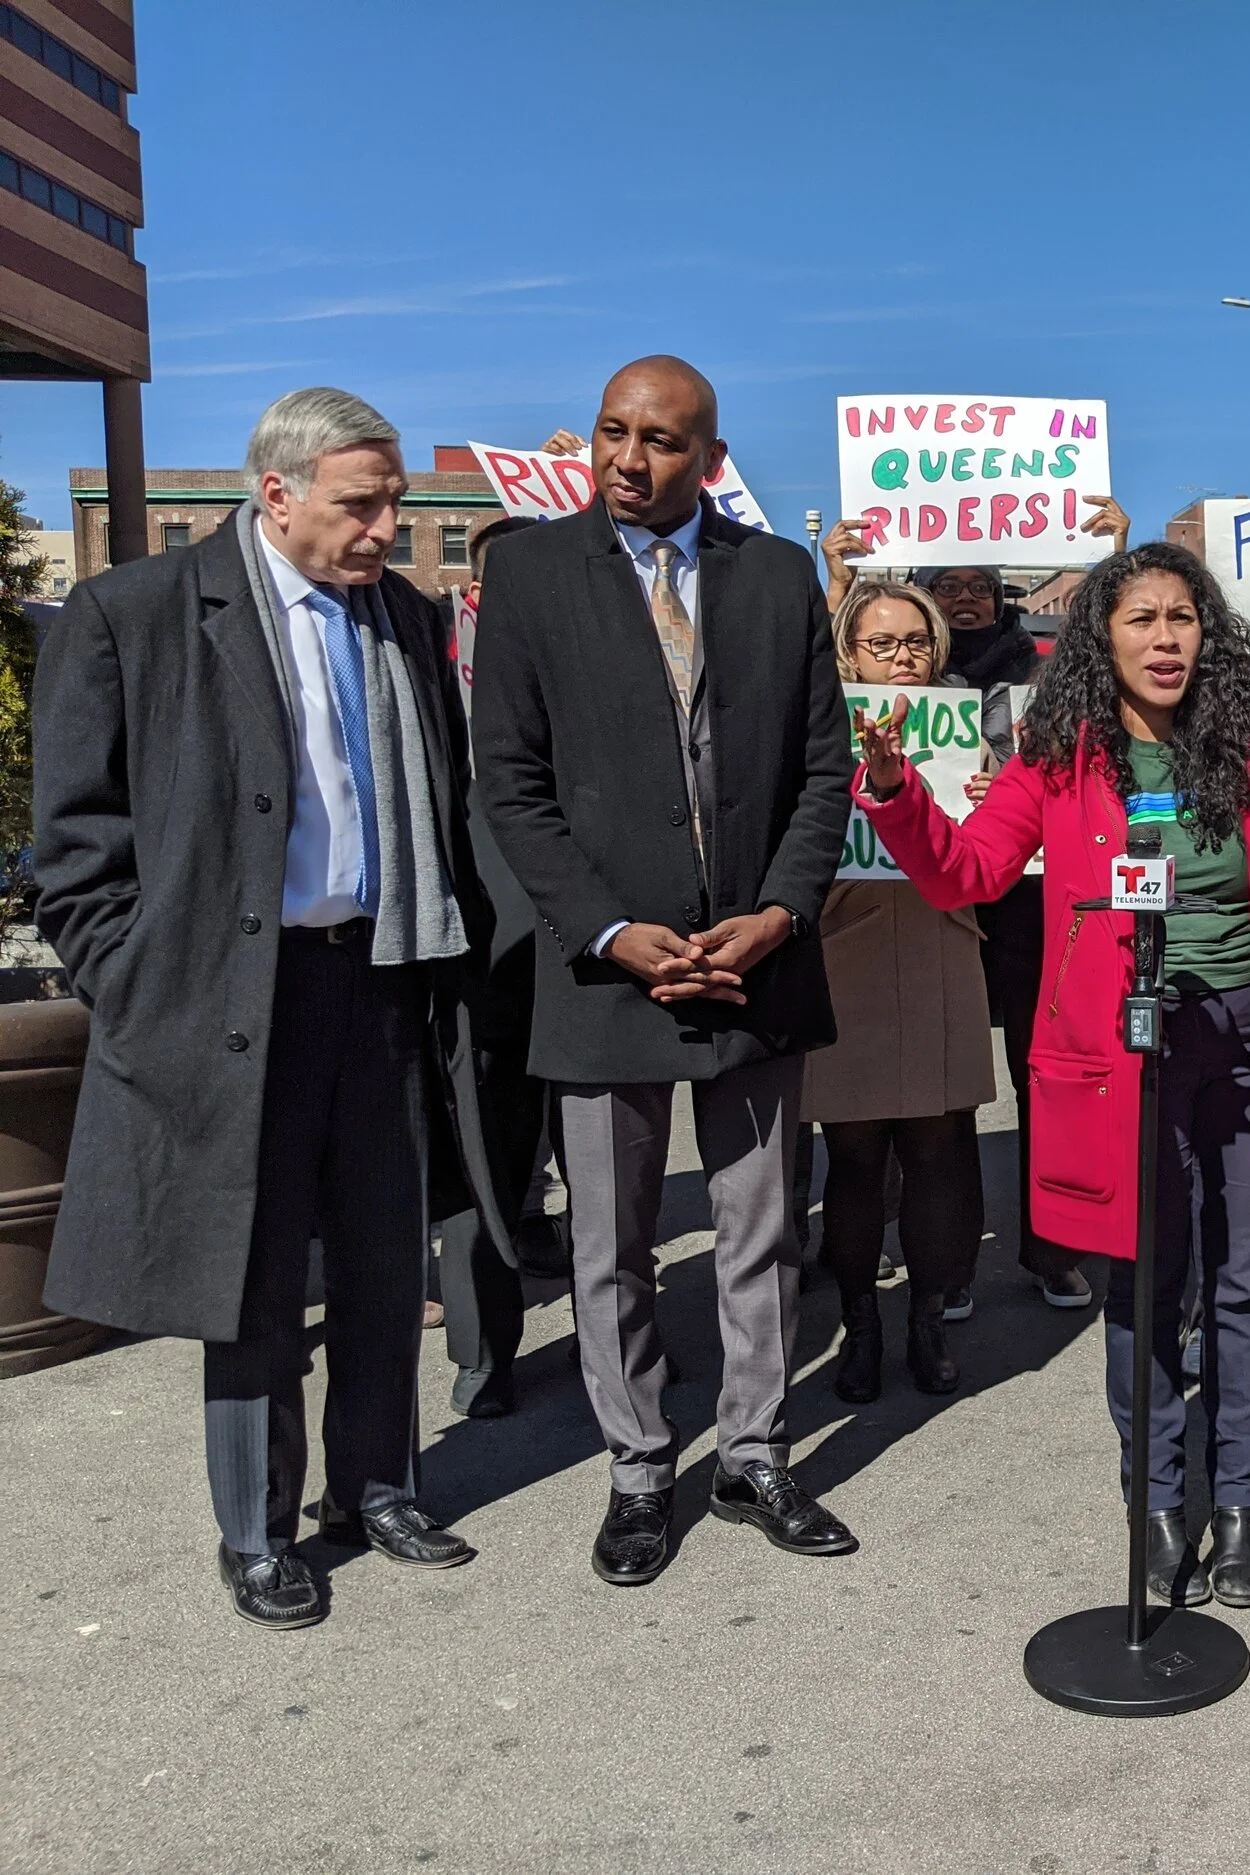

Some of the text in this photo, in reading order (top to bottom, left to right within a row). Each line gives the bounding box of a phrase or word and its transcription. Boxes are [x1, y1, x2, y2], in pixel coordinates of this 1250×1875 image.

[846, 403, 1096, 438] INVEST IN
[872, 444, 1080, 490] QUEENS
[861, 489, 1076, 546] RIDERS!
[1140, 881, 1161, 894] 47
